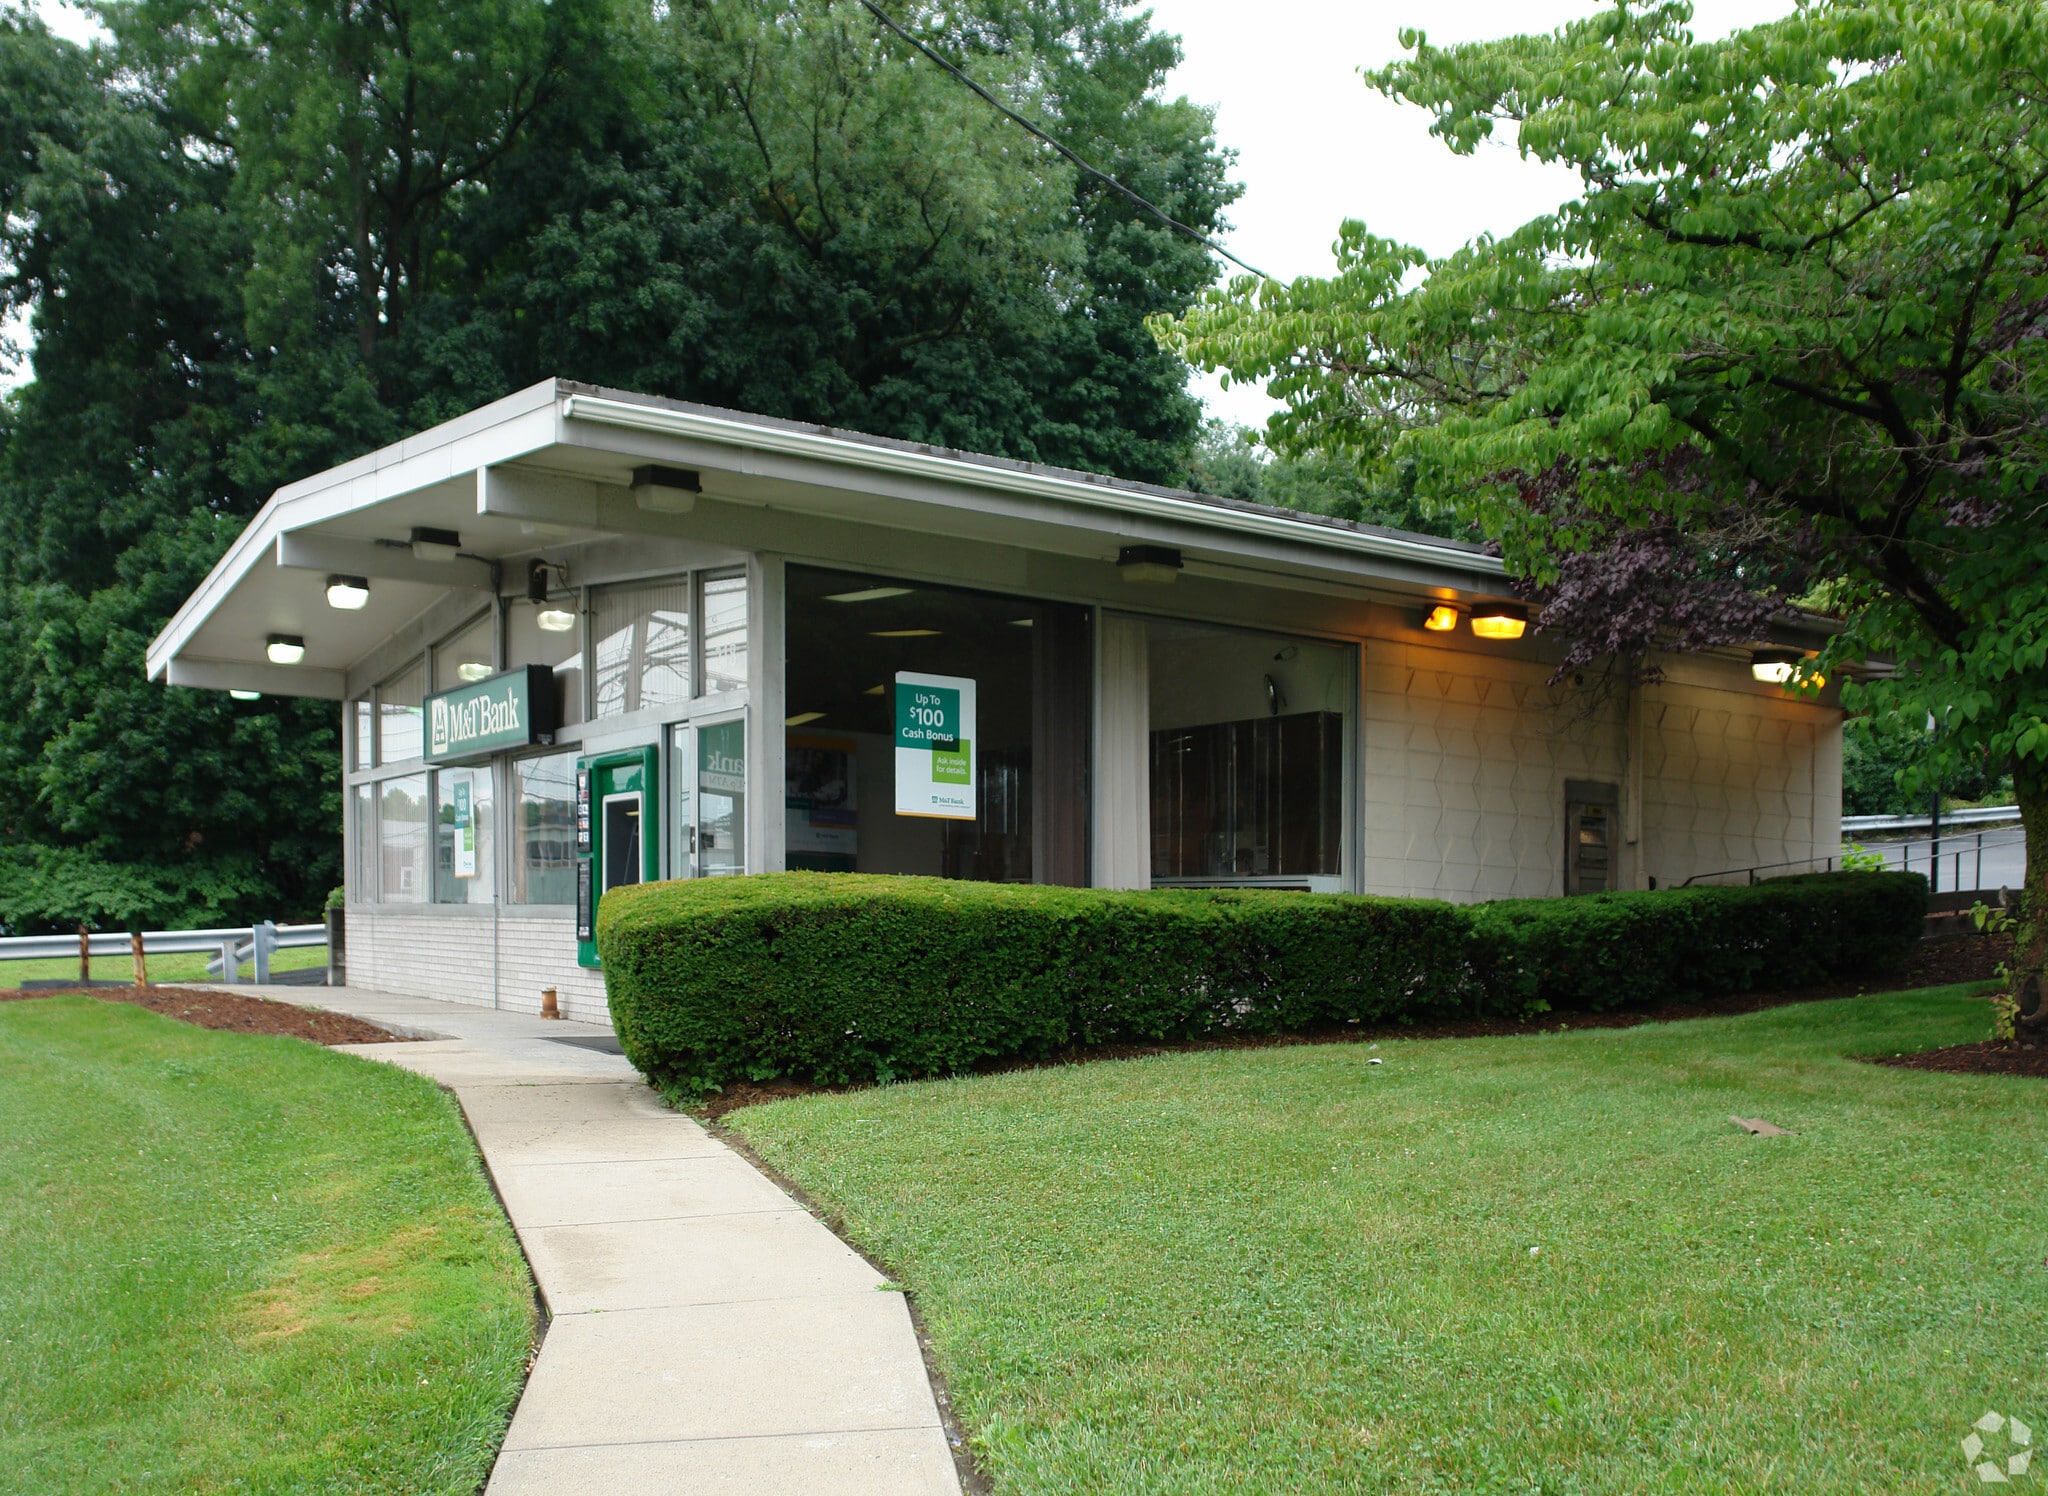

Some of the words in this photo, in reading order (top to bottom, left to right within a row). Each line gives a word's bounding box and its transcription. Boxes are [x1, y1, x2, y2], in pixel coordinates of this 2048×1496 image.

[915, 692, 929, 707] Up
[929, 694, 941, 706] To
[449, 697, 480, 743] M&T
[479, 686, 520, 736] Bank
[909, 706, 945, 728] $100
[902, 727, 925, 739] Cash
[926, 729, 954, 742] Bonus
[936, 765, 946, 773] for
[937, 757, 948, 765] Ask
[949, 757, 967, 767] inside
